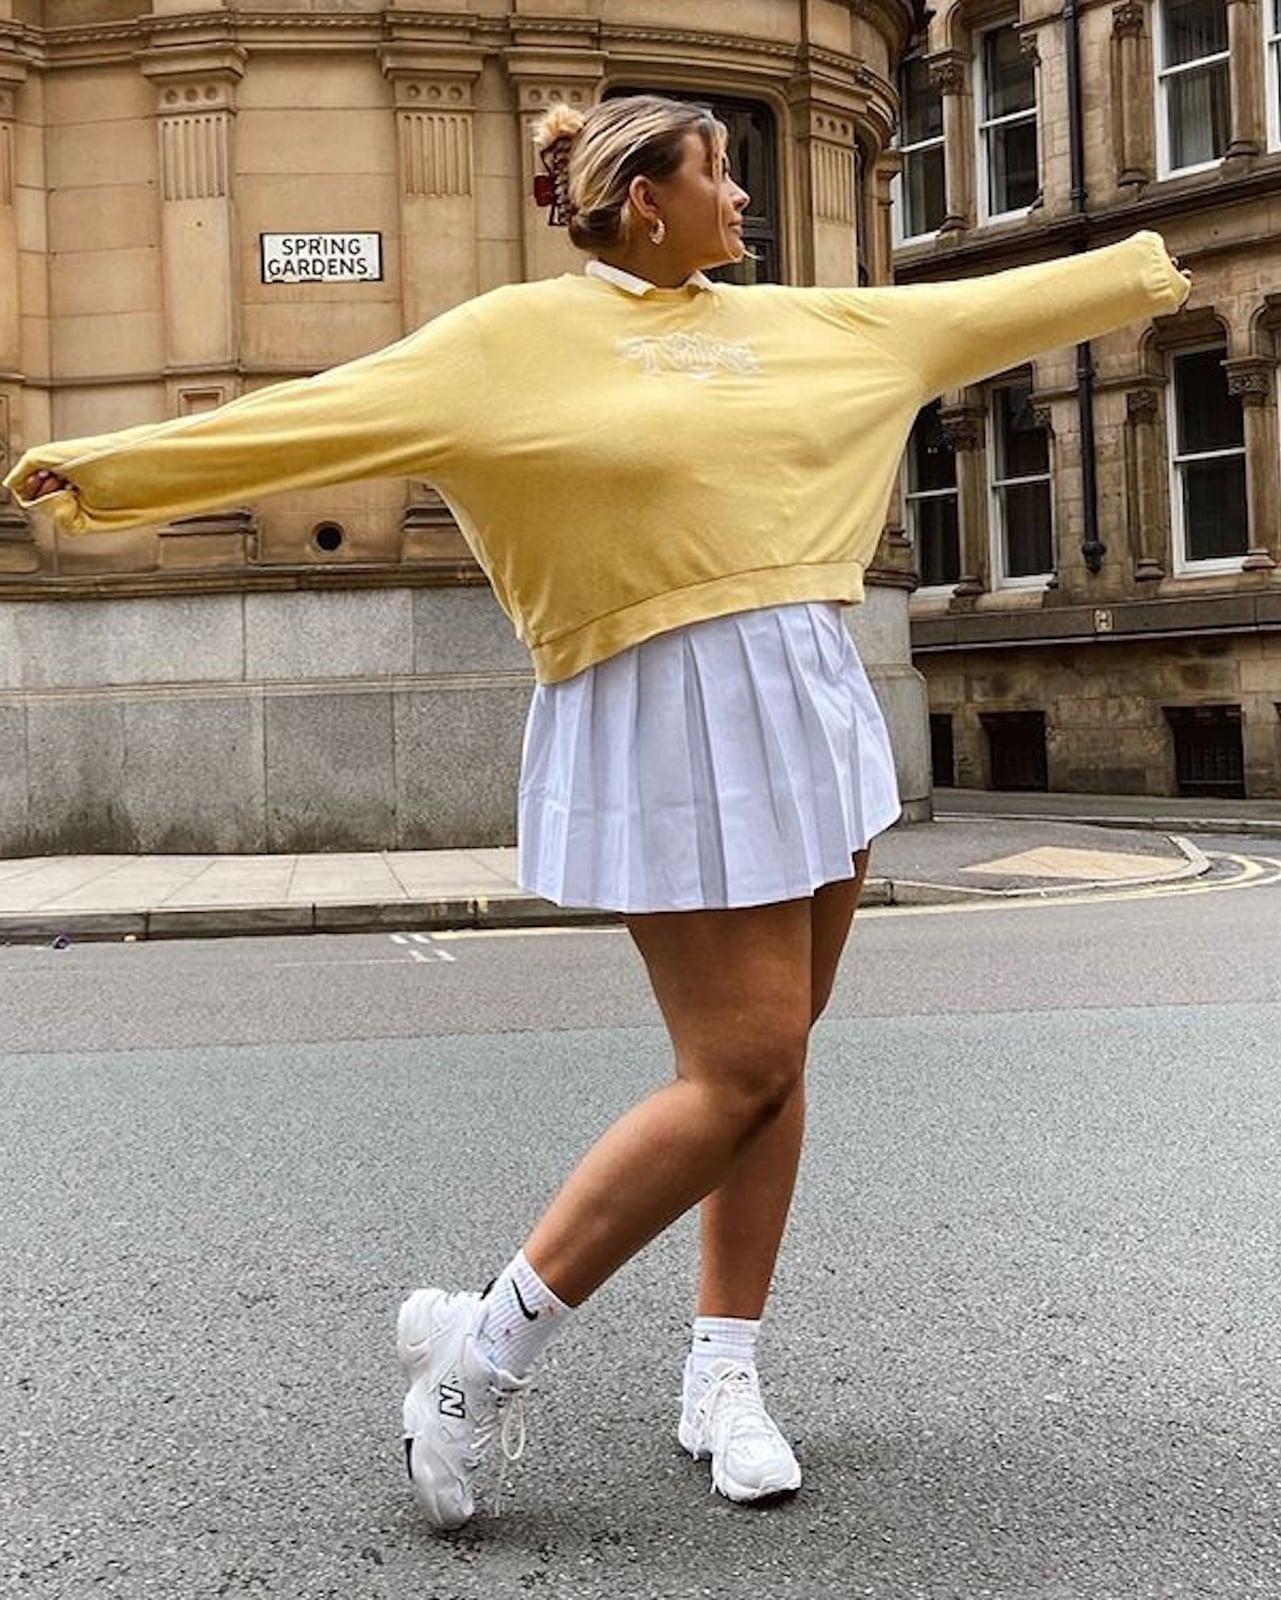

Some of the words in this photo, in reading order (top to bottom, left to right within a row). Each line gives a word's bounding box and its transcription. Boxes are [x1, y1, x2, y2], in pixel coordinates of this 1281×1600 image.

[282, 238, 361, 256] SPRING
[267, 258, 368, 275] GARDENS
[439, 1384, 465, 1418] N
